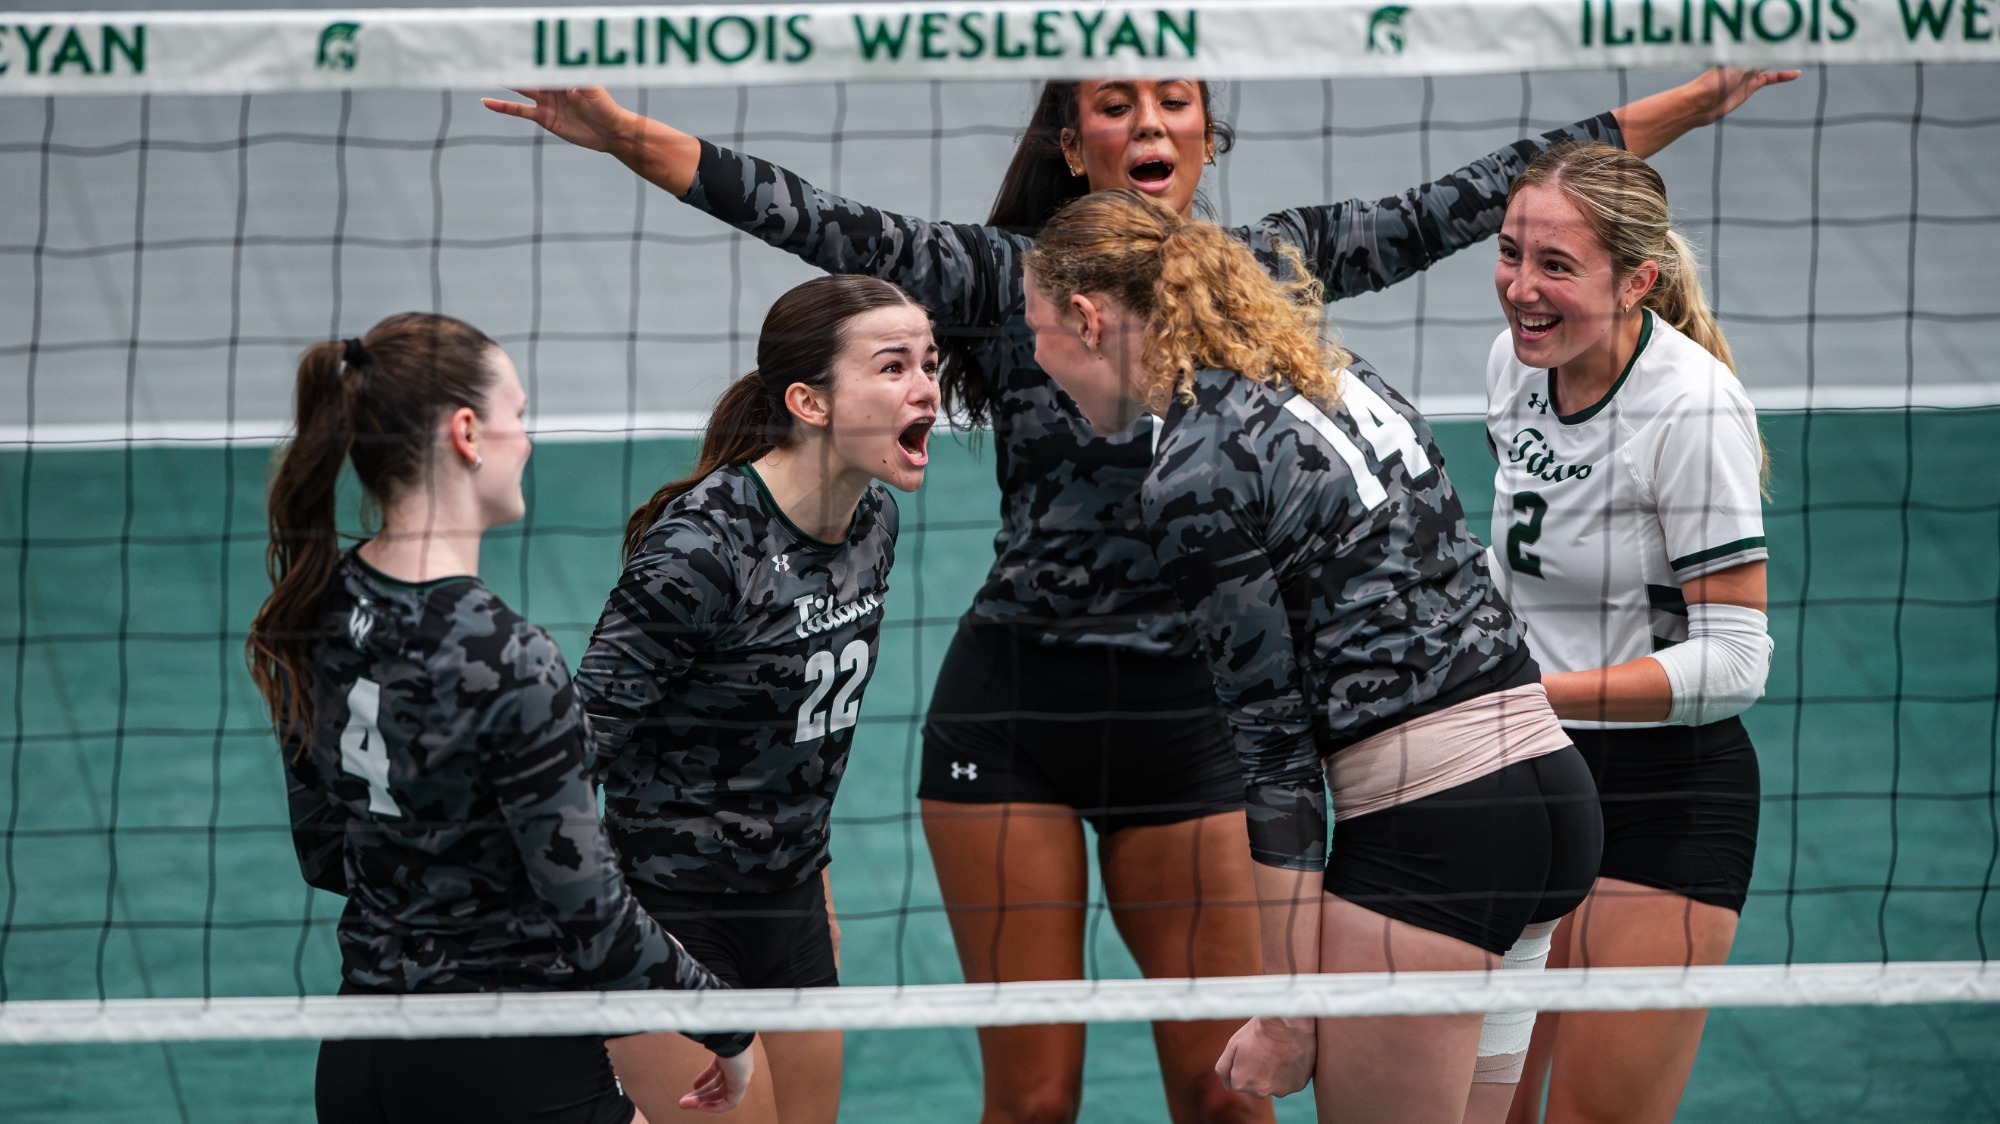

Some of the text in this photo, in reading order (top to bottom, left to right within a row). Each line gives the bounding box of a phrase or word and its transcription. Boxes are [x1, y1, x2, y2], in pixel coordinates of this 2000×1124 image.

[534, 10, 1197, 67] ILLINOIS WESLEYAN
[1580, 0, 1857, 46] ILLINOIS
[1283, 367, 1432, 512] 14
[1507, 490, 1549, 581] 2
[794, 639, 870, 743] 22
[339, 676, 402, 817] 4
